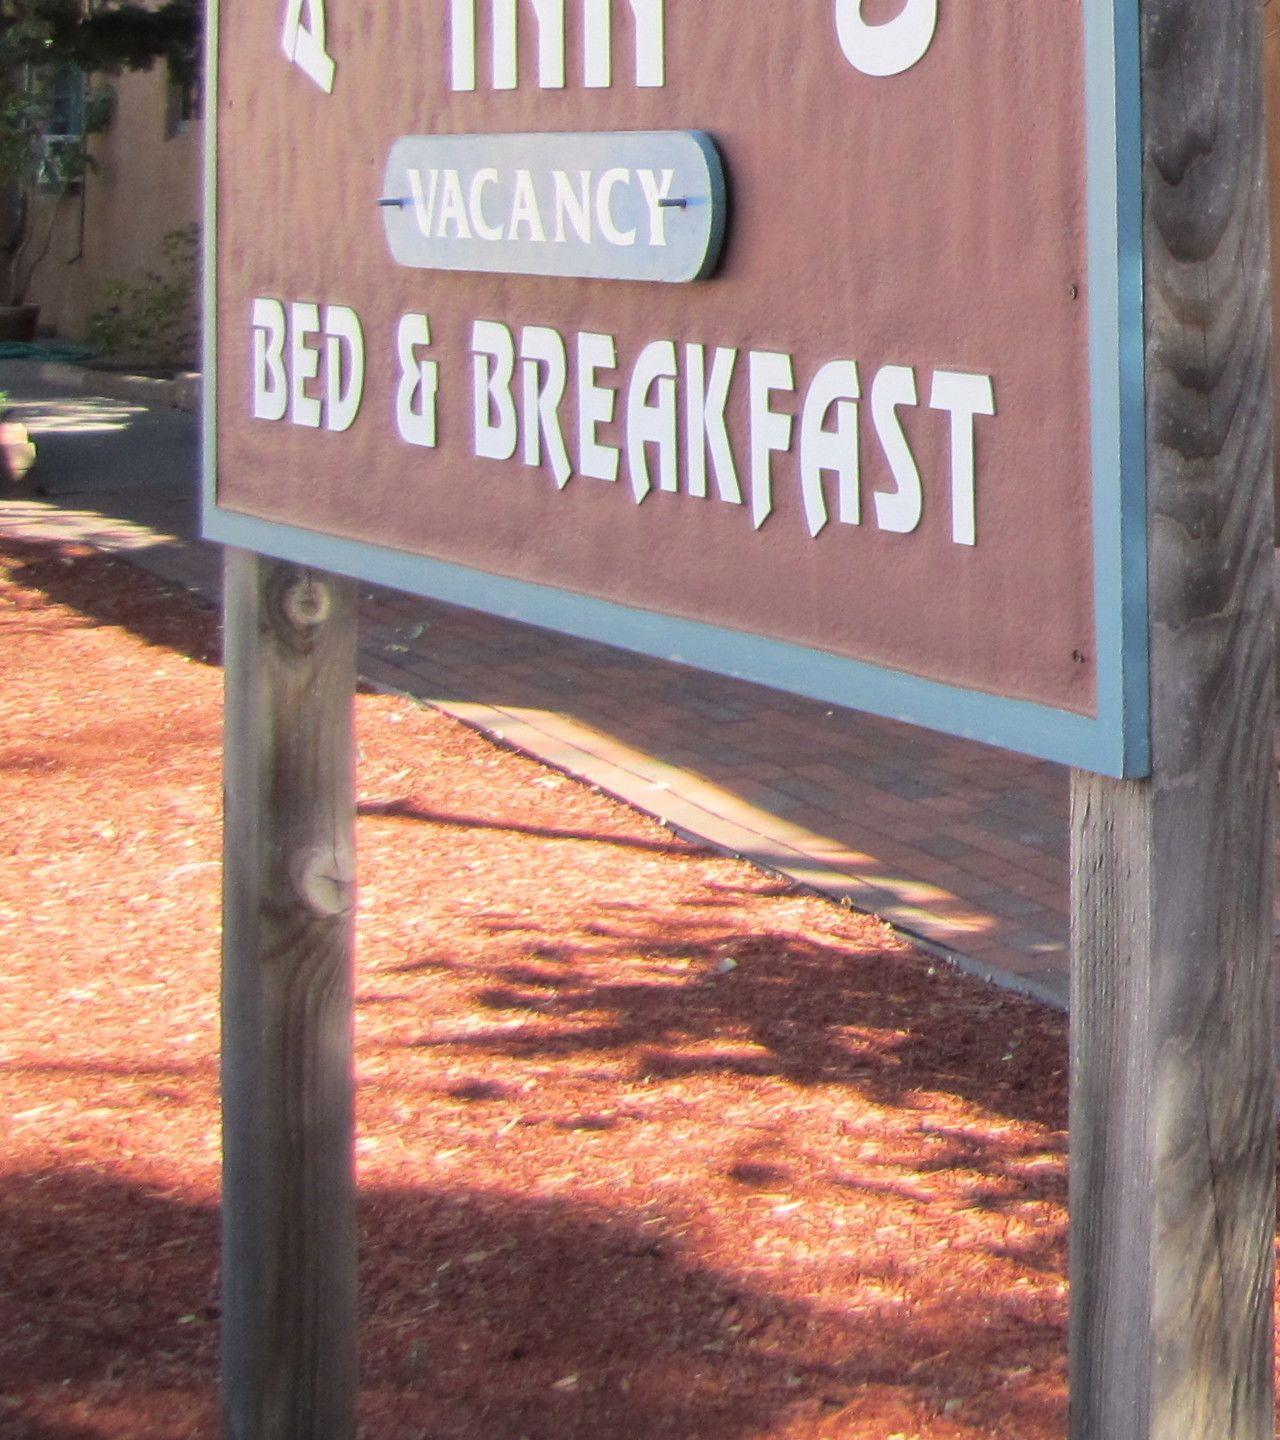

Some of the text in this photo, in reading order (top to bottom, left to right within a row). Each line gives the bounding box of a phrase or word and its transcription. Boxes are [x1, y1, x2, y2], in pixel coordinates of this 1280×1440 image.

[407, 168, 675, 247] VACANCY
[251, 297, 995, 547] BED & BREAKFAST
